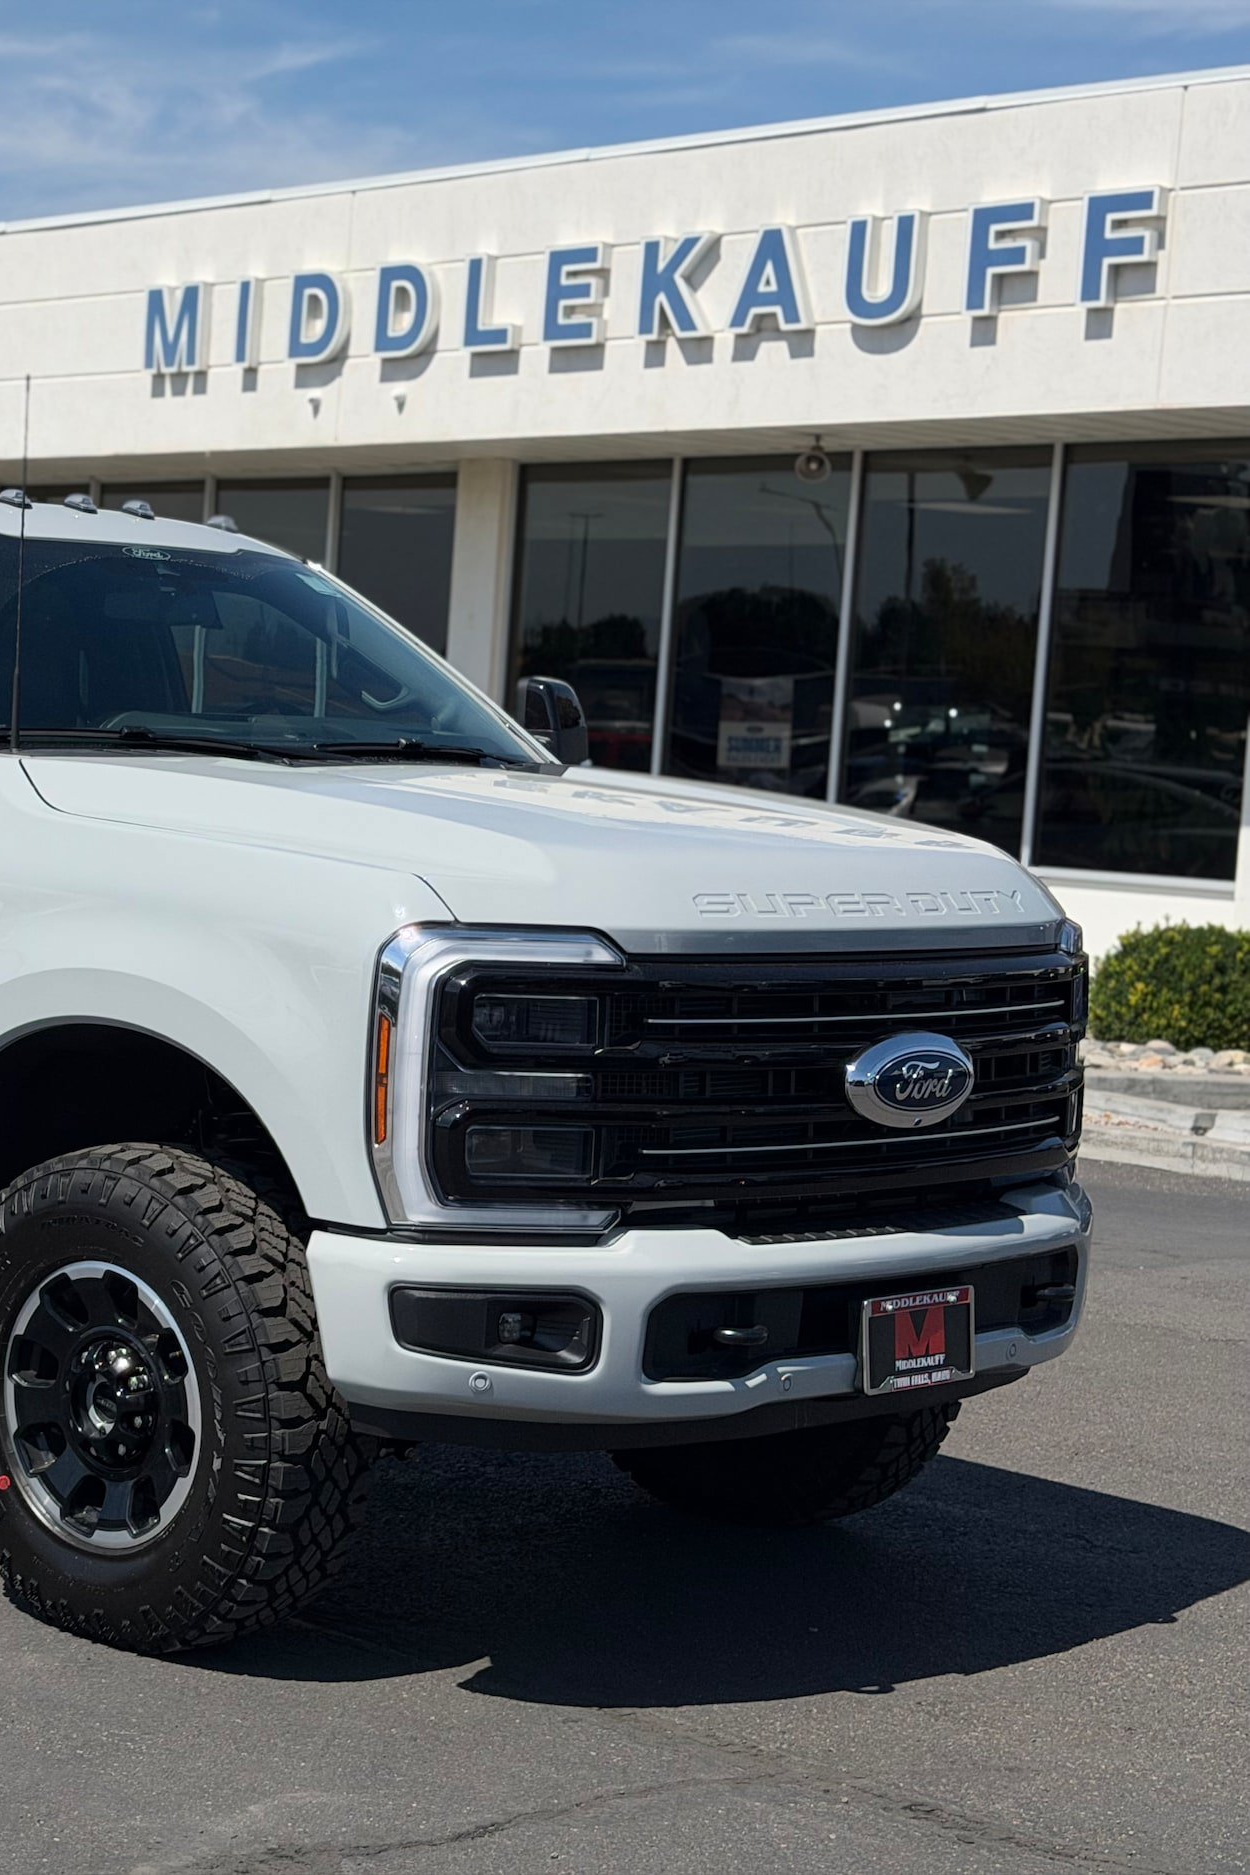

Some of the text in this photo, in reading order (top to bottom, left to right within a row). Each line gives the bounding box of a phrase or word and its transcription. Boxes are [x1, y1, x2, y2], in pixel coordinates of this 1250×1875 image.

[143, 187, 1164, 373] MIDDLEKAUFF
[692, 889, 1026, 918] SUPER DUTY
[895, 1061, 952, 1101] Ford
[894, 1305, 945, 1360] M
[895, 1353, 946, 1372] MIDDLEKAUFF
